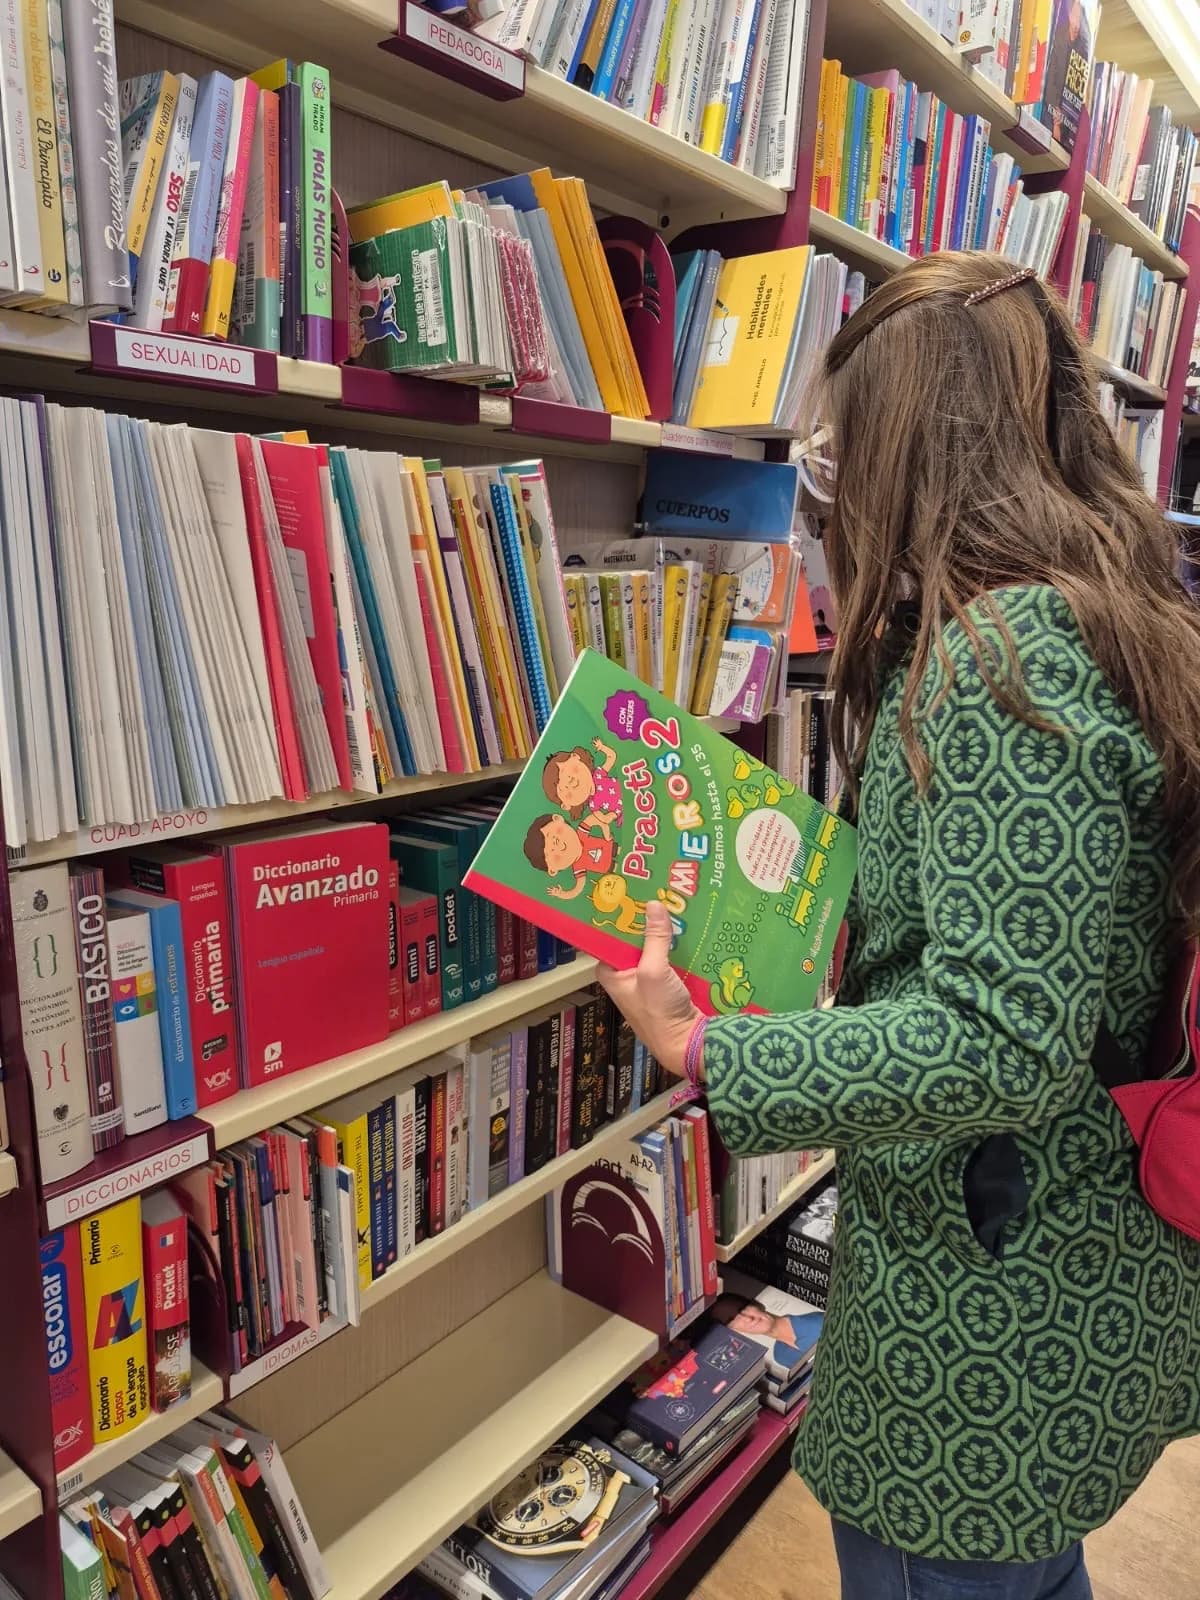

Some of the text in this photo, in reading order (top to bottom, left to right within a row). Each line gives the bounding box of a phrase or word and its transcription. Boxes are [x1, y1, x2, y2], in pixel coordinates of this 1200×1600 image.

[97, 60, 115, 96] mi
[757, 57, 768, 96] BONITO
[97, 102, 117, 131] de
[36, 118, 55, 210] El Principito
[100, 138, 127, 255] Recuerdos
[166, 171, 185, 214] SEXO
[312, 148, 327, 270] MOLAS MUCHO
[161, 231, 173, 264] AHORA
[746, 273, 768, 340] Habilidades
[756, 287, 773, 339] mentales
[415, 313, 427, 343] Baraja
[130, 341, 242, 376] SEXUALIDAD
[655, 499, 731, 524] CUERPOS
[618, 707, 627, 725] CON
[626, 699, 636, 734] STICKERS
[621, 716, 681, 880] Practi 2
[690, 743, 725, 888] Jugamos hasta el 35
[90, 810, 209, 844] CUAD. APOYO
[746, 819, 766, 861] Actividades
[252, 852, 341, 882] Diccionario
[759, 862, 769, 881] para
[769, 835, 789, 878] los primeros
[778, 838, 797, 883] aprendizajes
[189, 889, 219, 902] española
[191, 881, 216, 892] Lengua
[255, 863, 379, 910] Avanzado
[333, 888, 380, 908] Primaria
[444, 893, 458, 943] pocket
[166, 943, 179, 995] refranes
[192, 939, 207, 1004] Diccionario
[202, 920, 231, 1016] primaria
[257, 945, 325, 969] Lengua española
[407, 947, 417, 978] mini
[426, 940, 437, 970] mini
[174, 1005, 185, 1063] diccionario
[549, 1018, 559, 1068] JOY FIELDING
[563, 1025, 571, 1058] HOOVER
[587, 1006, 595, 1048] REBECCA
[263, 1058, 285, 1075] sm
[625, 1065, 633, 1090] ONYX
[414, 1103, 427, 1154] TEACHER
[514, 1087, 525, 1137] DILEMMA
[584, 1093, 592, 1127] FOURTH
[371, 1130, 383, 1183] HOUSEMAID
[384, 1122, 395, 1173] HOUSEMAID
[402, 1113, 414, 1171] BOYFRIEND
[630, 1153, 655, 1173] A1-A2
[66, 1148, 192, 1216] DICCIONARIOS
[354, 1134, 365, 1213] THE HUNGER GAMES
[87, 1219, 100, 1265] Primaria
[785, 1240, 831, 1267] ESPECIAL
[786, 1233, 830, 1258] ENVIADO
[163, 1263, 175, 1311] Pocket
[786, 1257, 829, 1283] ENVIADO
[42, 1273, 68, 1369] escolar
[264, 1330, 318, 1371] IDIOMAS
[96, 1376, 111, 1431] Diccionario
[114, 1390, 125, 1427] Espasa
[126, 1356, 138, 1419] de la lengua
[137, 1365, 148, 1411] española
[449, 1575, 471, 1597] favor
